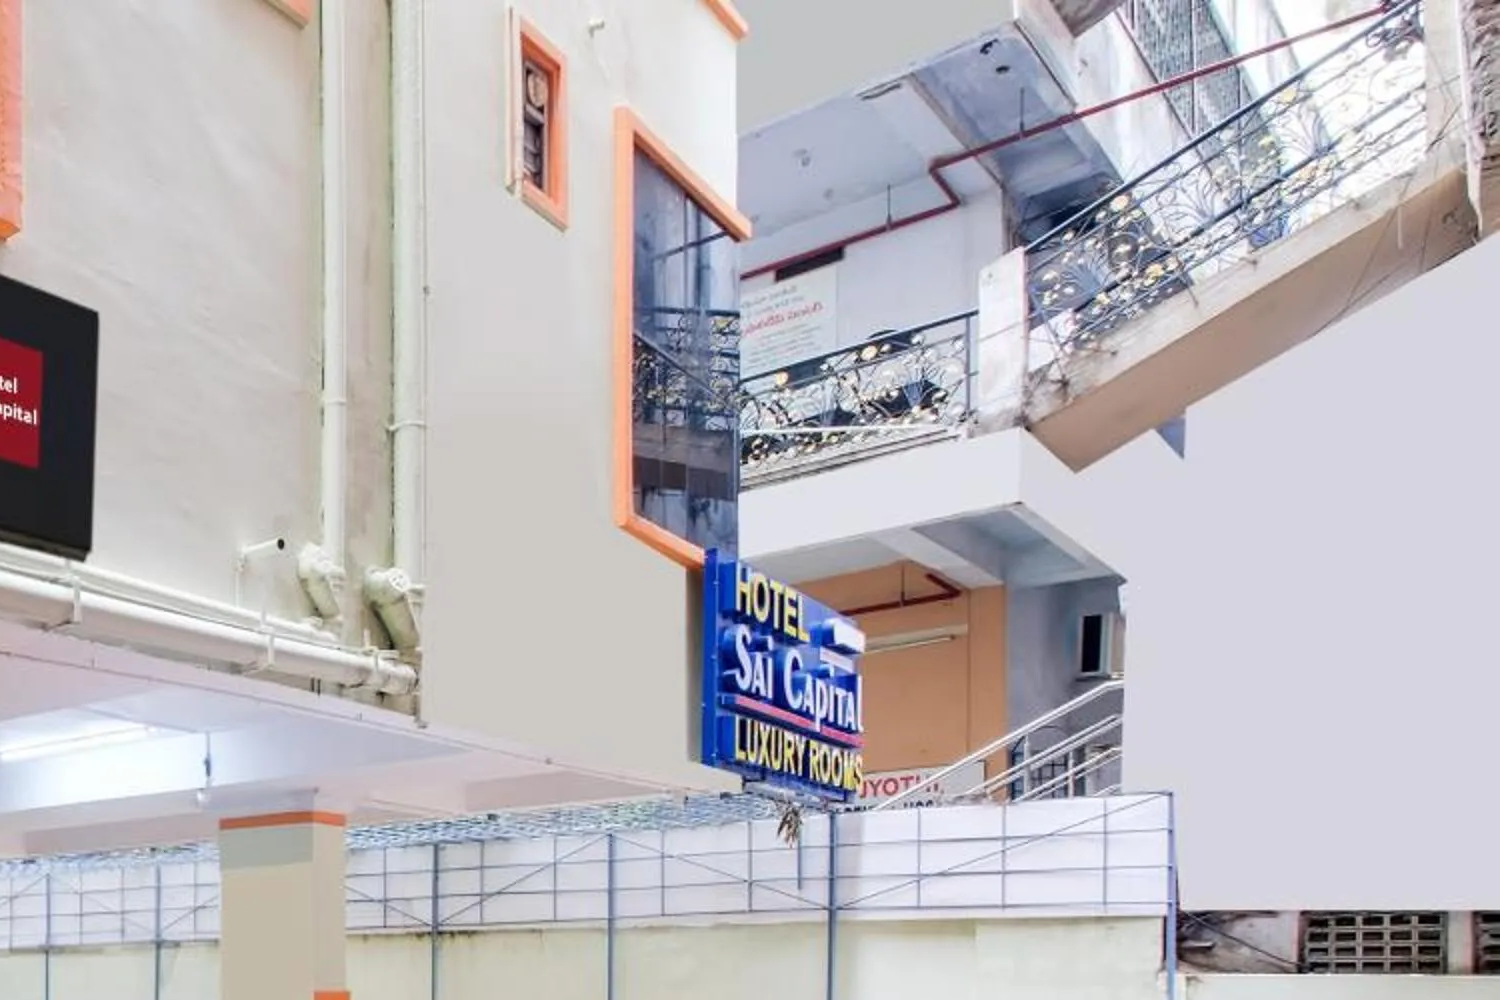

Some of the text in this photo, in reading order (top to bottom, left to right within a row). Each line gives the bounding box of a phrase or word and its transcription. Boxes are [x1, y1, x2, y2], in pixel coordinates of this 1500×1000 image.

[735, 559, 811, 643] HOTEL
[734, 713, 865, 796] LUXURY ROOMS
